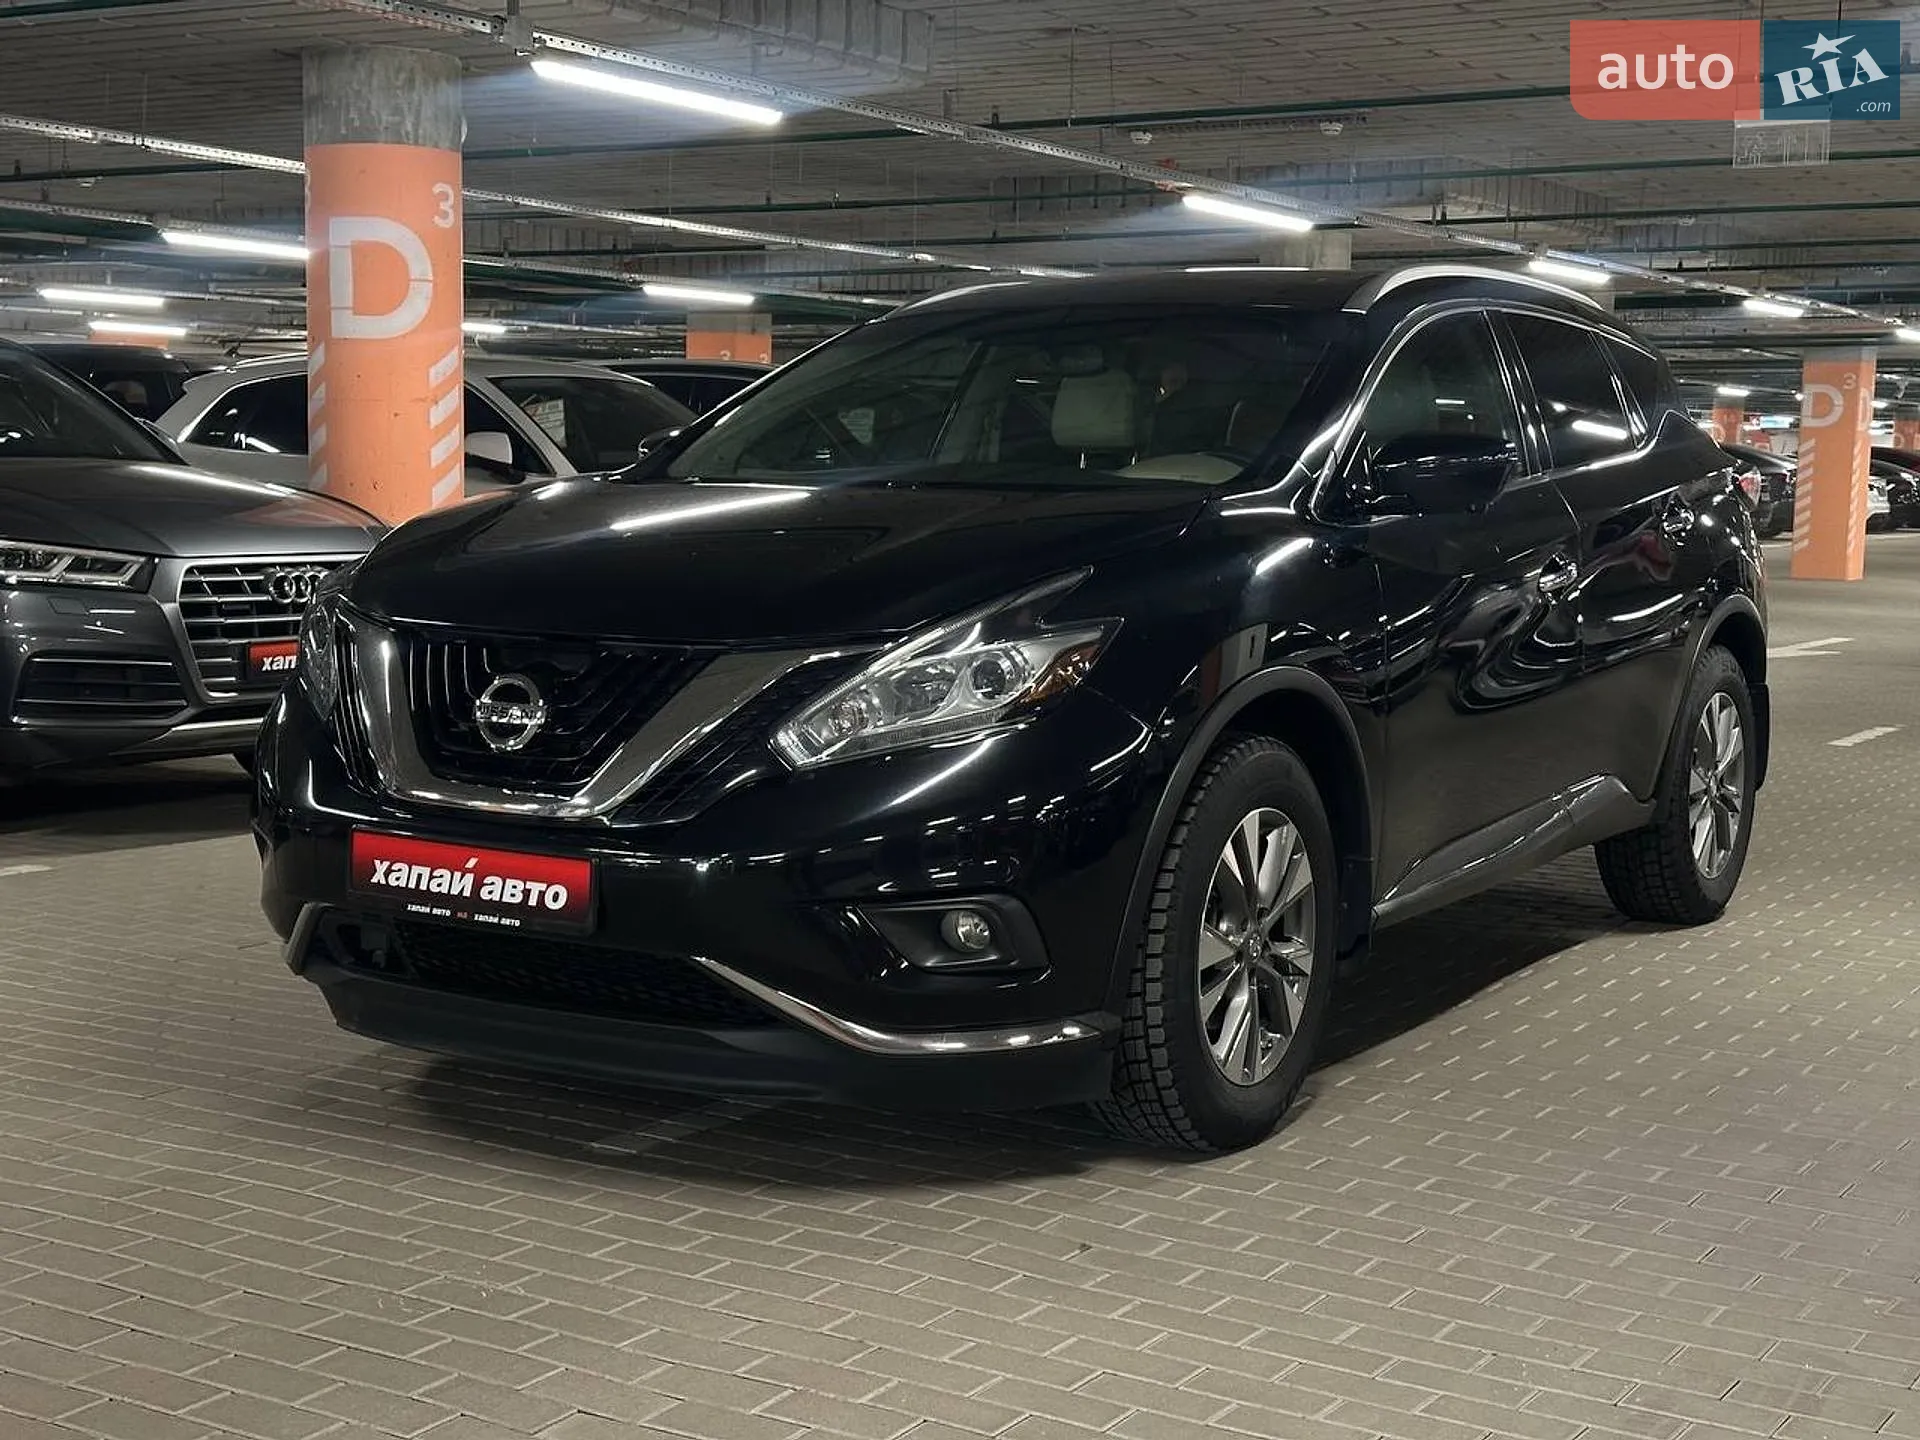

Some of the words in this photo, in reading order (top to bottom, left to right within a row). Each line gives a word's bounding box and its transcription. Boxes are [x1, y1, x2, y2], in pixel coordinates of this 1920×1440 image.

[329, 216, 433, 338] D
[432, 182, 455, 228] 3
[1802, 384, 1844, 427] D
[1843, 372, 1857, 390] 3
[262, 655, 297, 672] хап
[370, 857, 480, 897] хапай
[479, 875, 569, 911] авто
